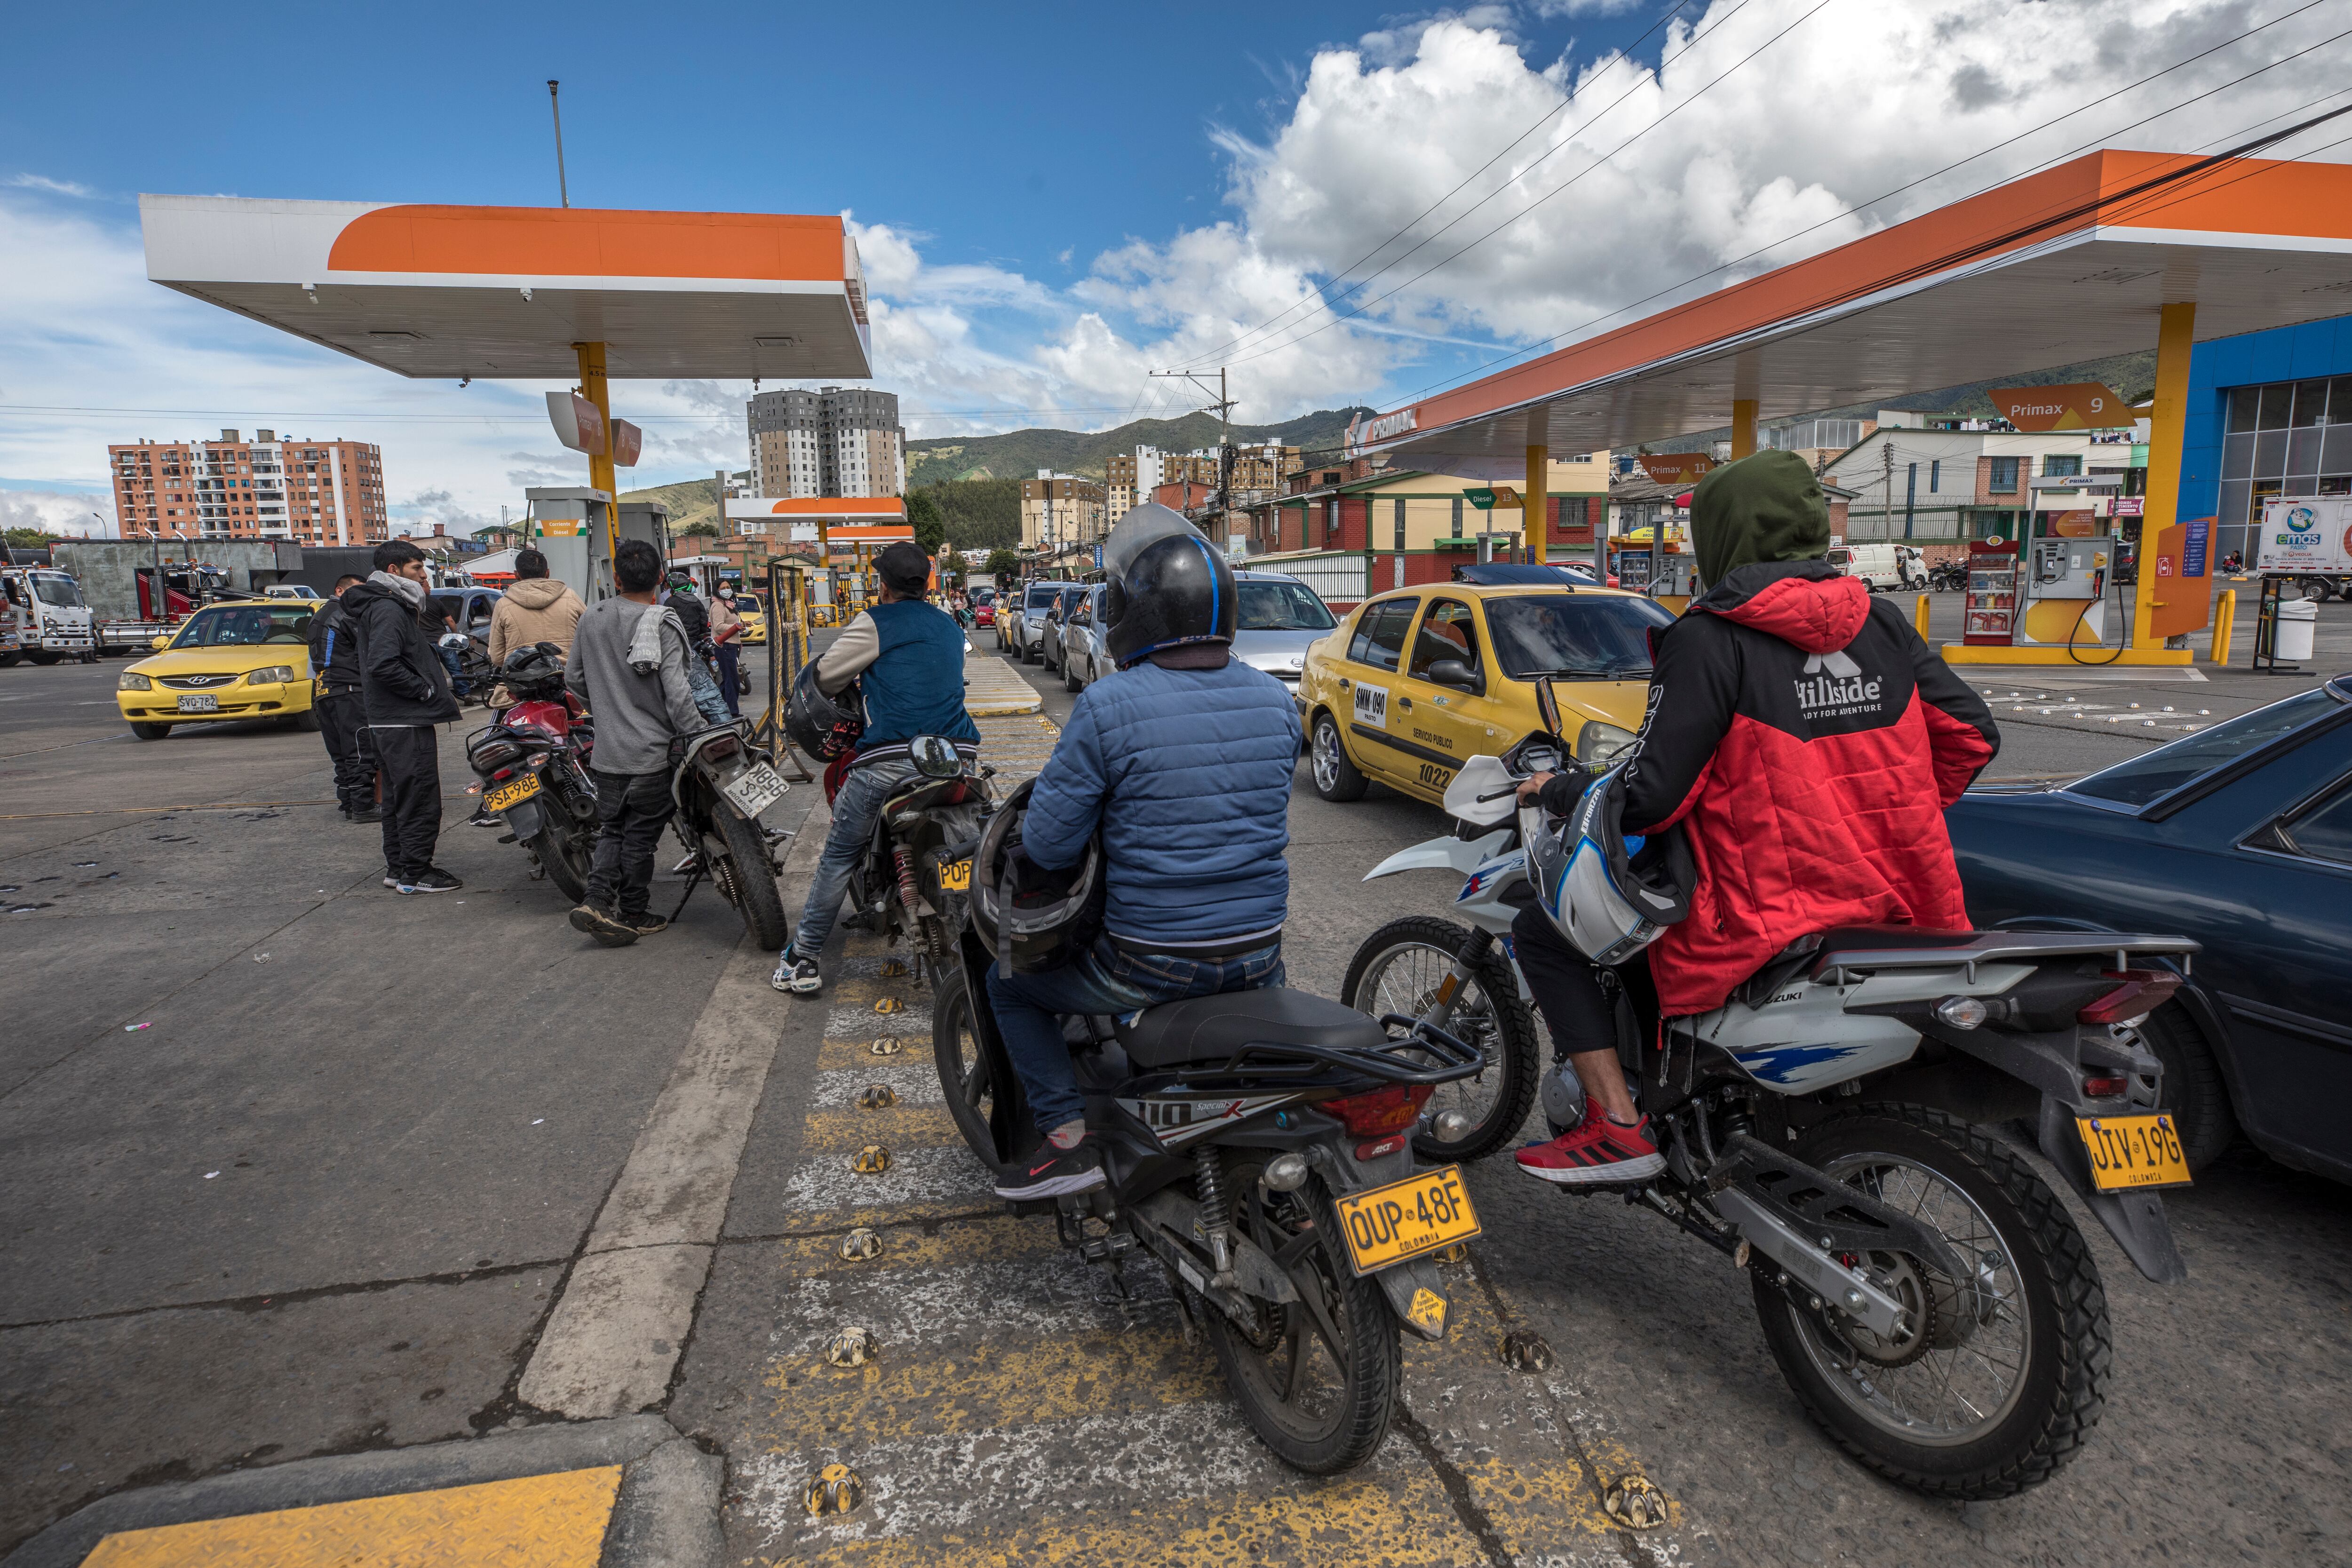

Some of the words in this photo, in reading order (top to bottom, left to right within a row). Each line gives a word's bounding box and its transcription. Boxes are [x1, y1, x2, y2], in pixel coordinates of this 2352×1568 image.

[2011, 404, 2063, 416] Primax
[2091, 398, 2103, 413] 9
[579, 414, 592, 431] Primax
[597, 421, 601, 436] 6
[1373, 408, 1417, 441] PRIMAX
[622, 434, 625, 447] 8
[629, 438, 639, 452] Primax
[1694, 463, 1706, 473] 11
[2278, 534, 2319, 544] emas
[1794, 677, 1880, 709] Hillside
[1356, 687, 1371, 712] SMM
[1373, 692, 1385, 716] 090
[1413, 727, 1432, 743] SERVICIO
[1433, 734, 1453, 749] PUBLICO
[749, 764, 787, 797] 958K
[1420, 764, 1450, 789] 1022
[506, 796, 525, 806] COLOMBIA
[728, 789, 753, 813] ECUADOR
[1197, 1101, 1227, 1111] Special
[1372, 1143, 1392, 1154] AKT
[2129, 1172, 2161, 1183] COLOMBIA
[1400, 1233, 1439, 1252] COLOMBIA
[1425, 1302, 1439, 1311] espera
